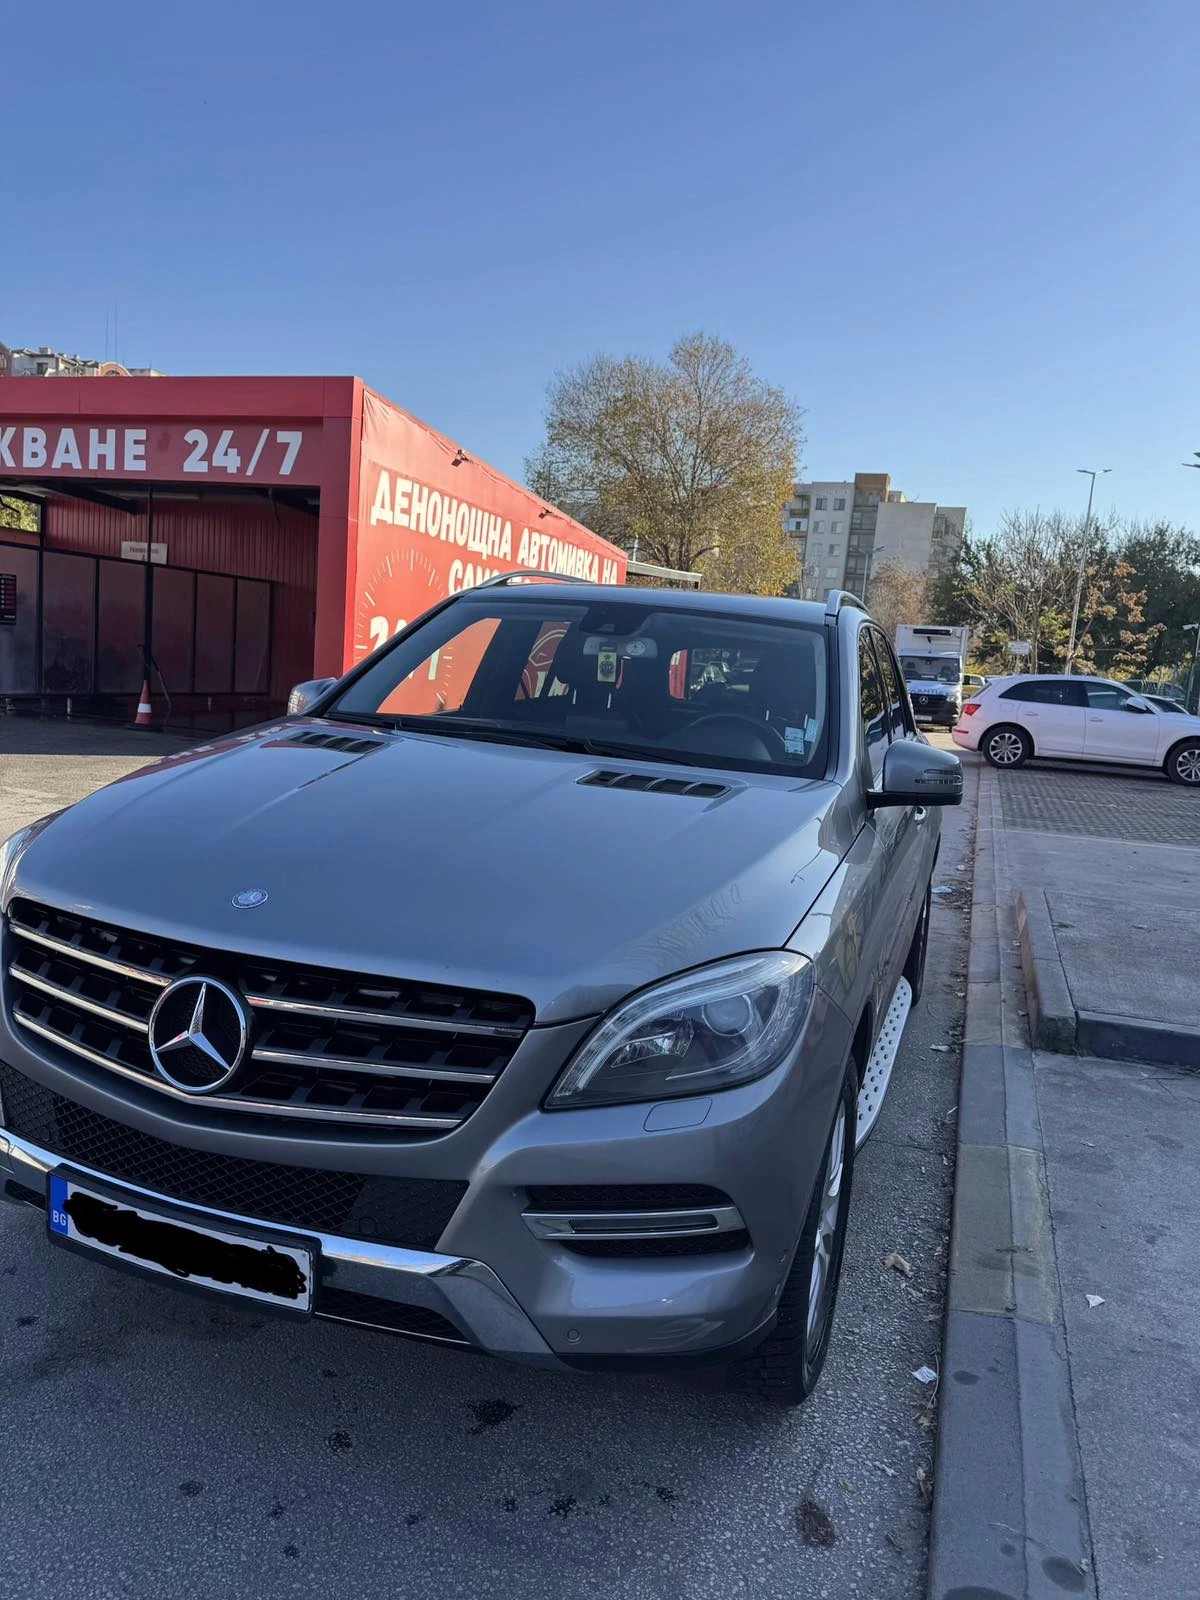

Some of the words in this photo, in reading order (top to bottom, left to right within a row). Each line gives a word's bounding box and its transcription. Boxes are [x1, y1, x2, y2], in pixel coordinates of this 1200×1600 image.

[183, 428, 303, 476] 24/7
[369, 469, 512, 561] ДЕНОНОЩНА
[516, 528, 599, 584] АВТОМИВКА
[601, 557, 618, 585] НА
[52, 1209, 67, 1226] BG
